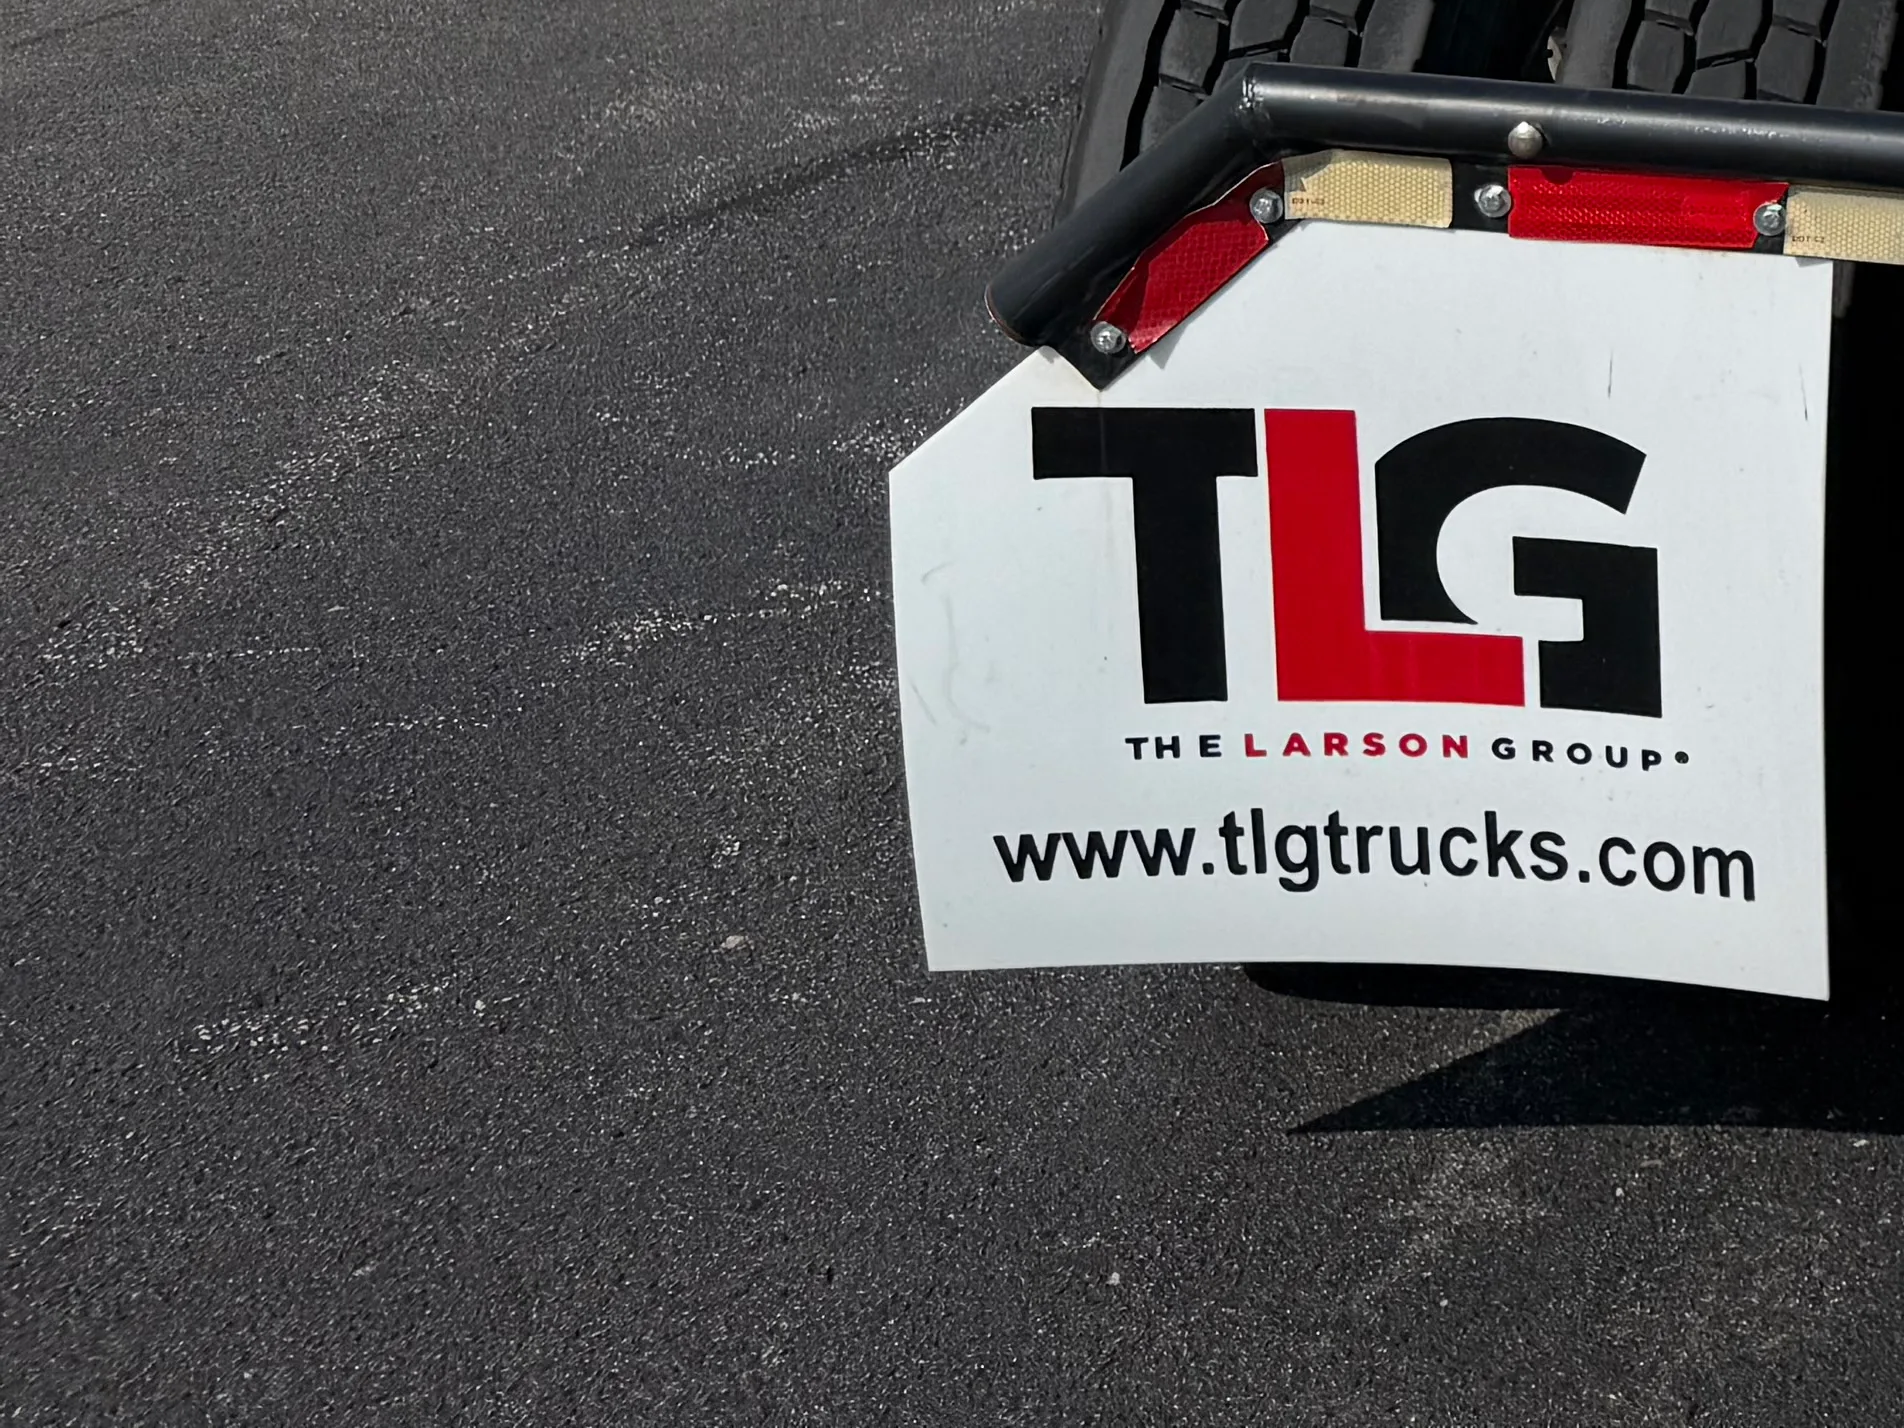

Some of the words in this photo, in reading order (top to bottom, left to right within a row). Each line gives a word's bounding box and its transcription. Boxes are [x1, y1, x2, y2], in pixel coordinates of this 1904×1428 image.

[1031, 406, 1664, 719] TLG
[1125, 735, 1222, 761] THE
[1245, 733, 1469, 760] LARSON
[993, 808, 1756, 902] www.tlgtrucks.com
